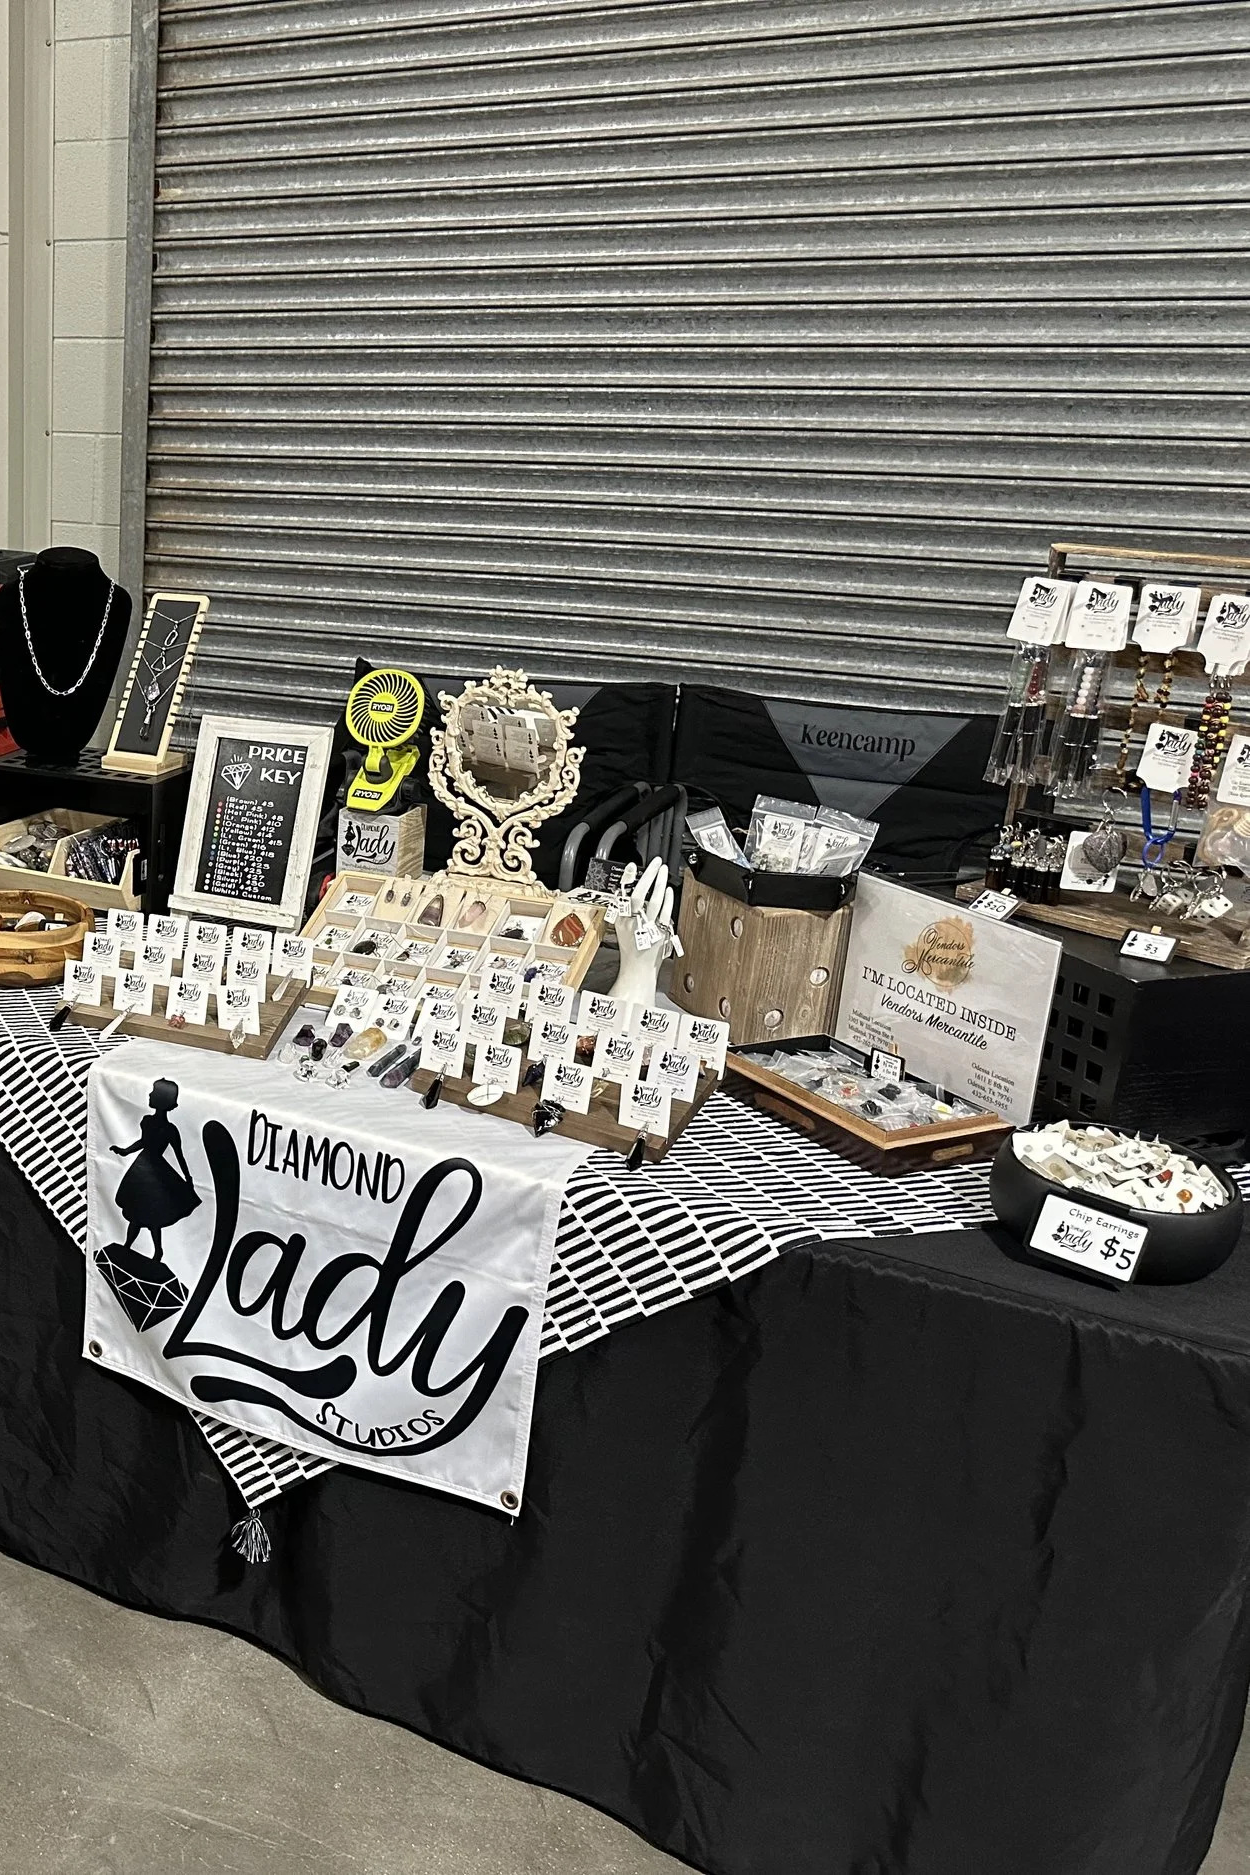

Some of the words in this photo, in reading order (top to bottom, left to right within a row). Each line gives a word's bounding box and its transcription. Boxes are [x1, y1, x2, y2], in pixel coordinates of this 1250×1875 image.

[372, 703, 393, 712] RYOBI
[248, 745, 306, 764] PRICE
[801, 724, 915, 761] Keencamp
[260, 768, 301, 785] KEY
[354, 790, 380, 798] RYOBI
[353, 825, 395, 864] Lady
[983, 901, 1006, 913] $20
[924, 928, 965, 950] Vendors
[1144, 943, 1159, 954] $3
[902, 949, 975, 975] Mercantile
[862, 966, 885, 986] I'M
[887, 979, 957, 1015] LOCATED
[960, 1006, 1016, 1042] INSIDE
[880, 994, 923, 1023] Vendors
[925, 1014, 987, 1050] Mercantile
[975, 1073, 986, 1082] 1611
[992, 1071, 1014, 1086] Location
[247, 1109, 404, 1204] DIAMOND
[1069, 1208, 1092, 1224] Chip
[1096, 1217, 1139, 1239] Earrings
[1059, 1225, 1093, 1253] Lady
[1100, 1236, 1135, 1270] $5
[163, 1119, 529, 1457] Lady
[316, 1402, 445, 1447] STUDIOS
